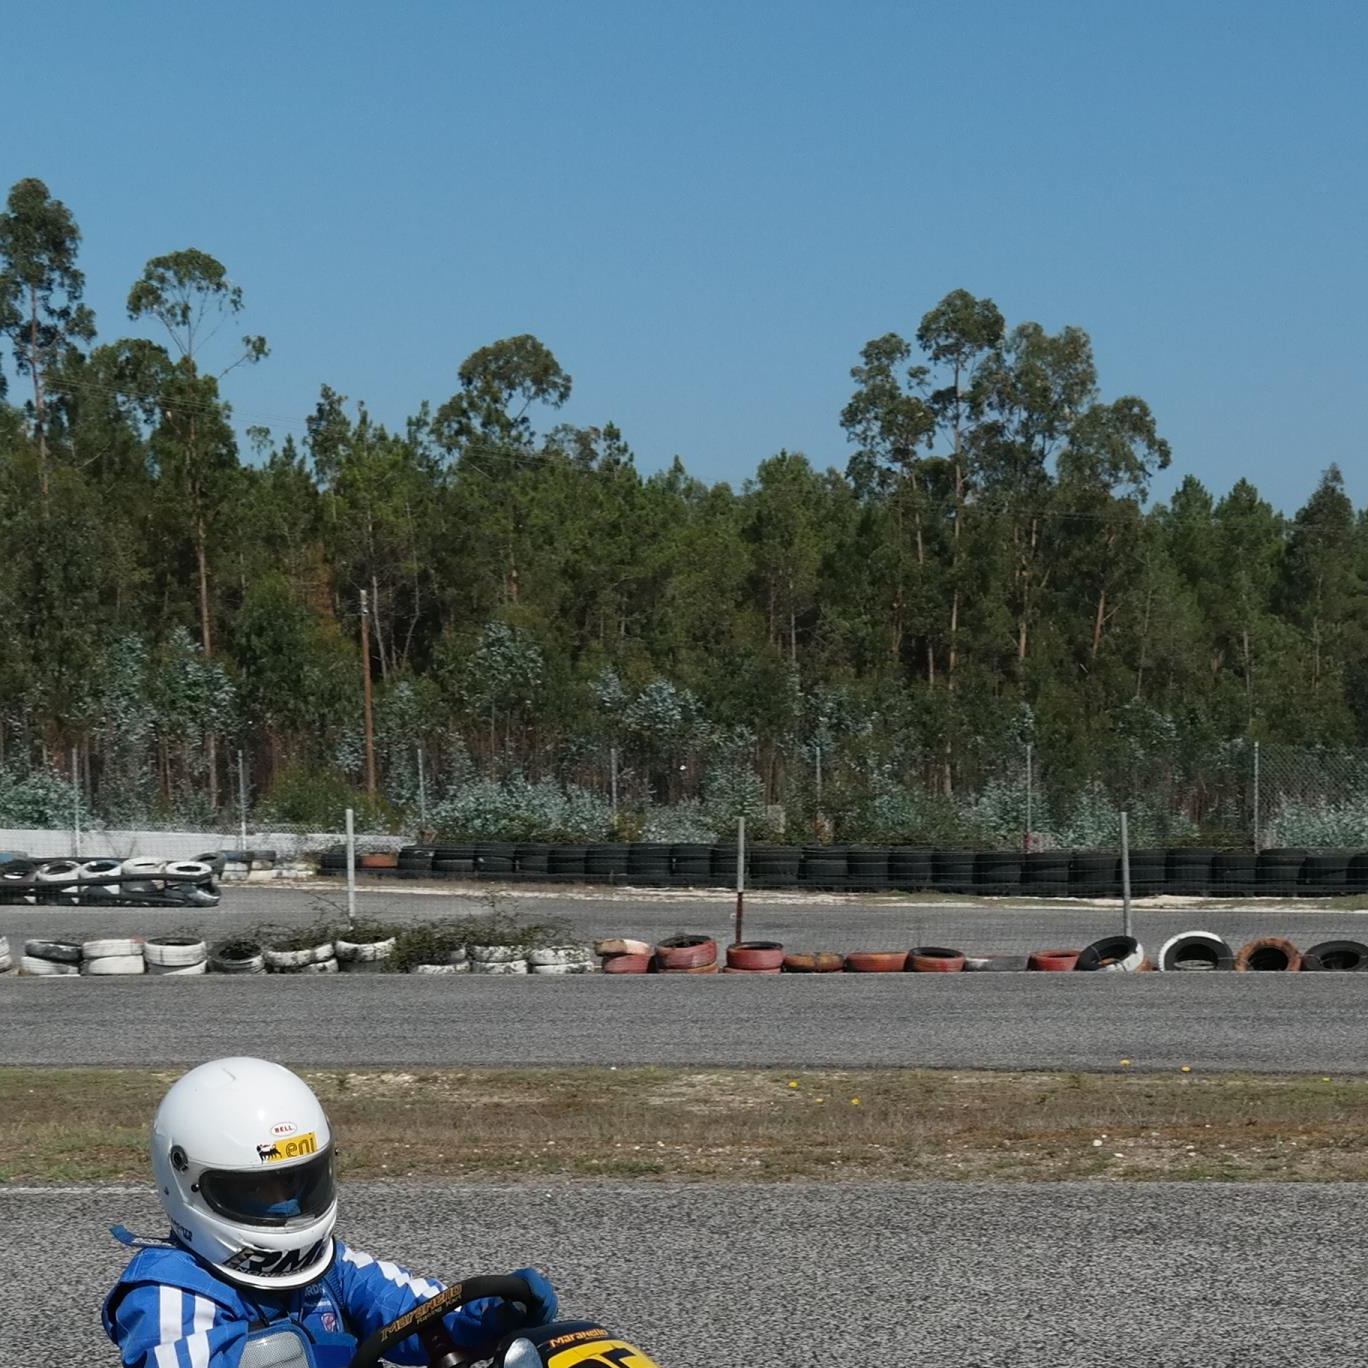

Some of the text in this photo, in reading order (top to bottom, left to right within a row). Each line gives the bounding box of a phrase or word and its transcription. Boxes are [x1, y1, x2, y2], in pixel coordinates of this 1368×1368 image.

[274, 1126, 294, 1136] BELL
[284, 1132, 317, 1158] eni
[549, 1328, 609, 1348] Maranello
